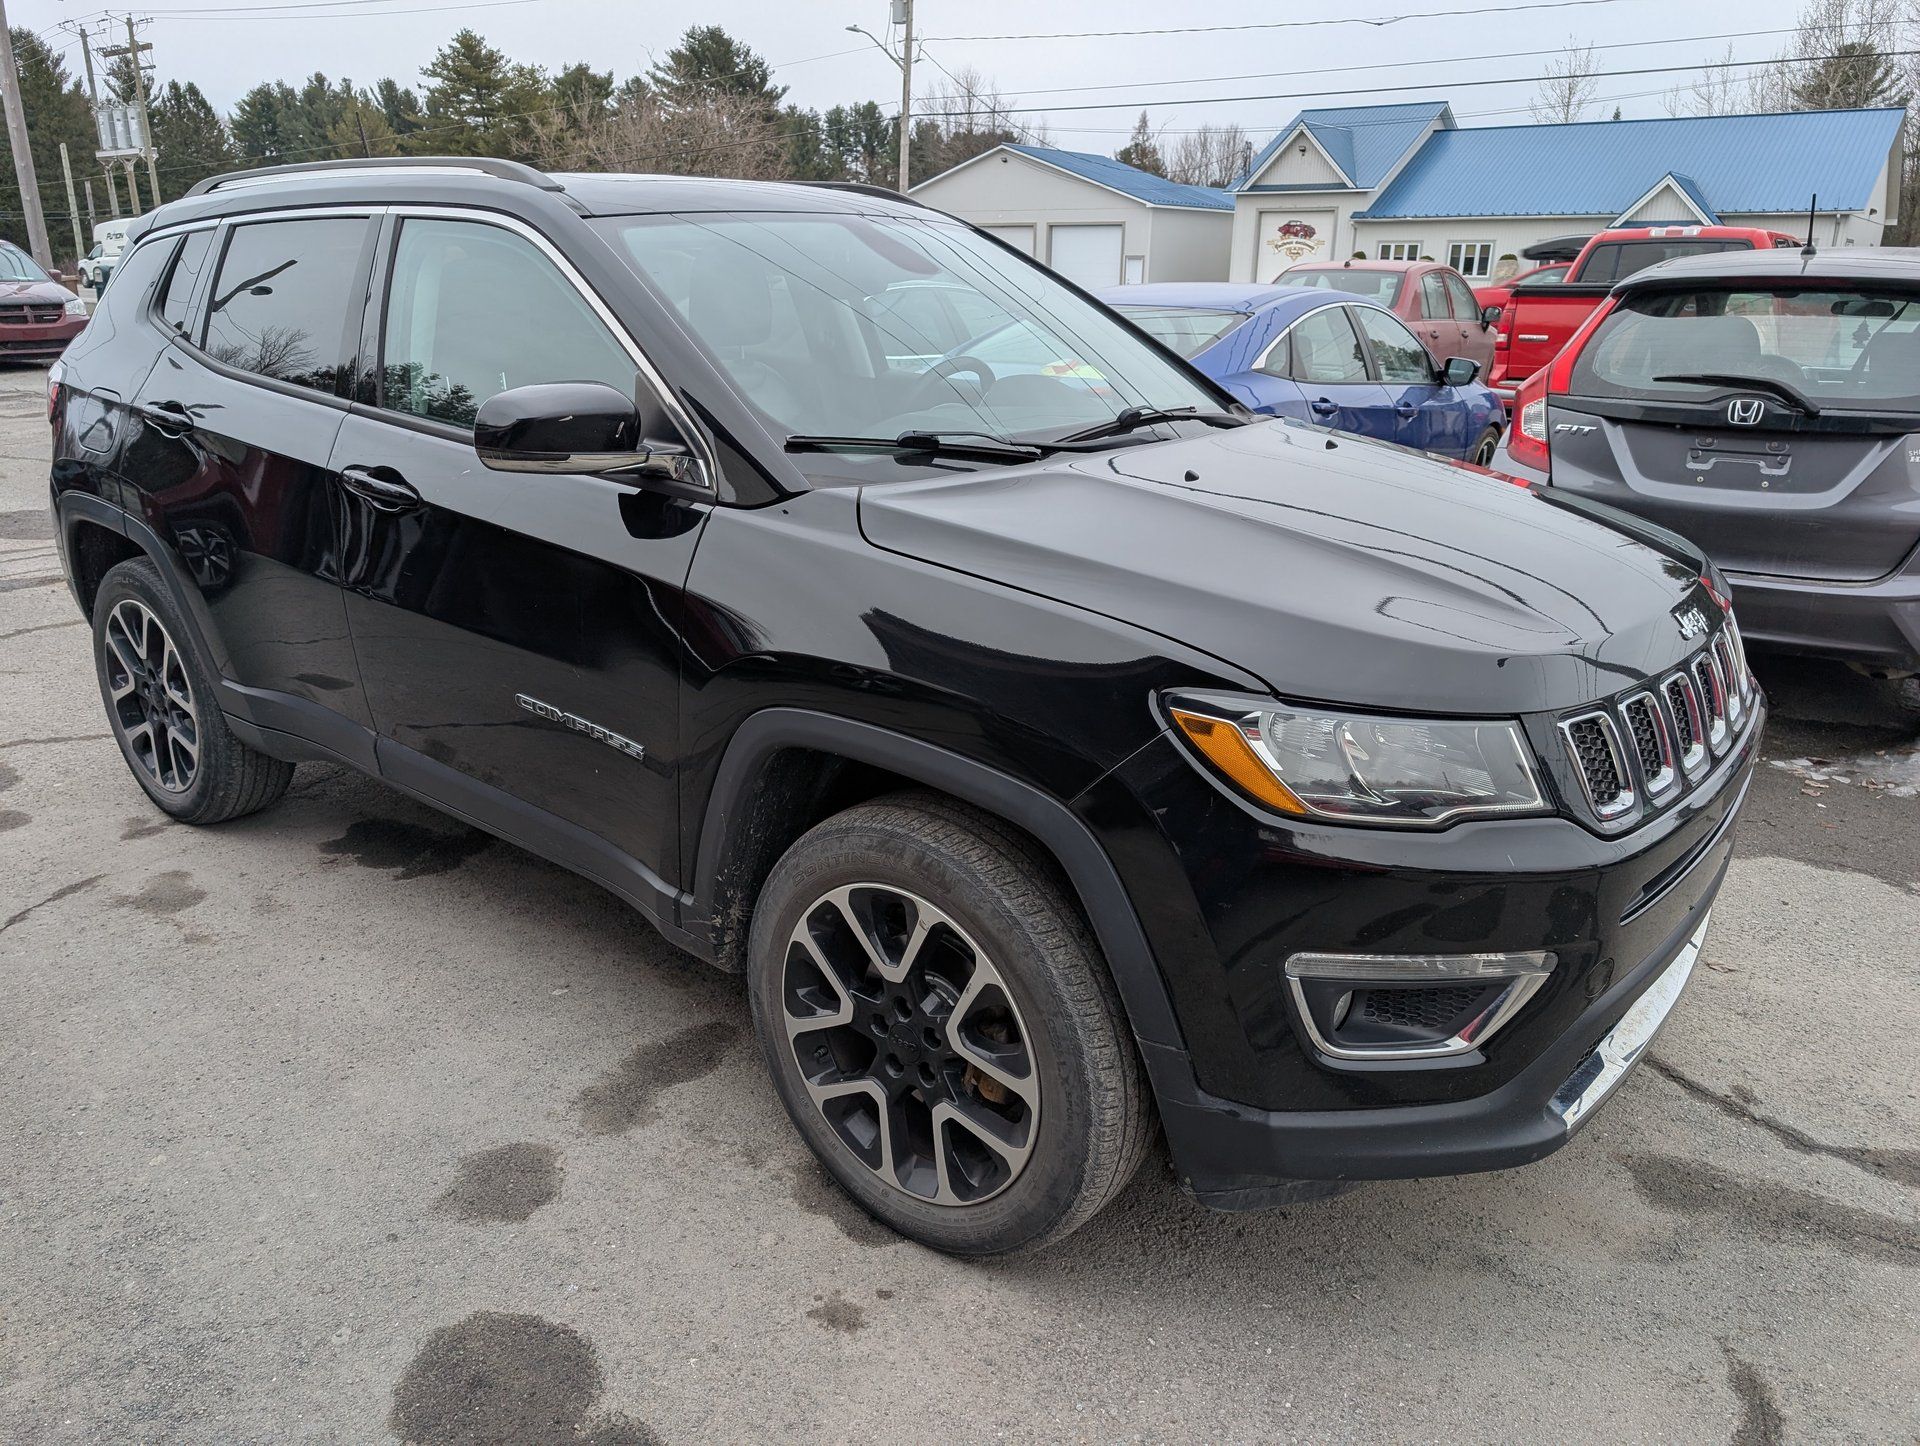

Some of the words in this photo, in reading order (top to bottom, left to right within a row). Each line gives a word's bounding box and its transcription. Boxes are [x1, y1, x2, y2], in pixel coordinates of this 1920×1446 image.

[1554, 423, 1598, 436] FIT
[1673, 607, 1709, 639] Jeep
[514, 692, 646, 761] COMPASS
[792, 852, 938, 888] CONTINENTA
